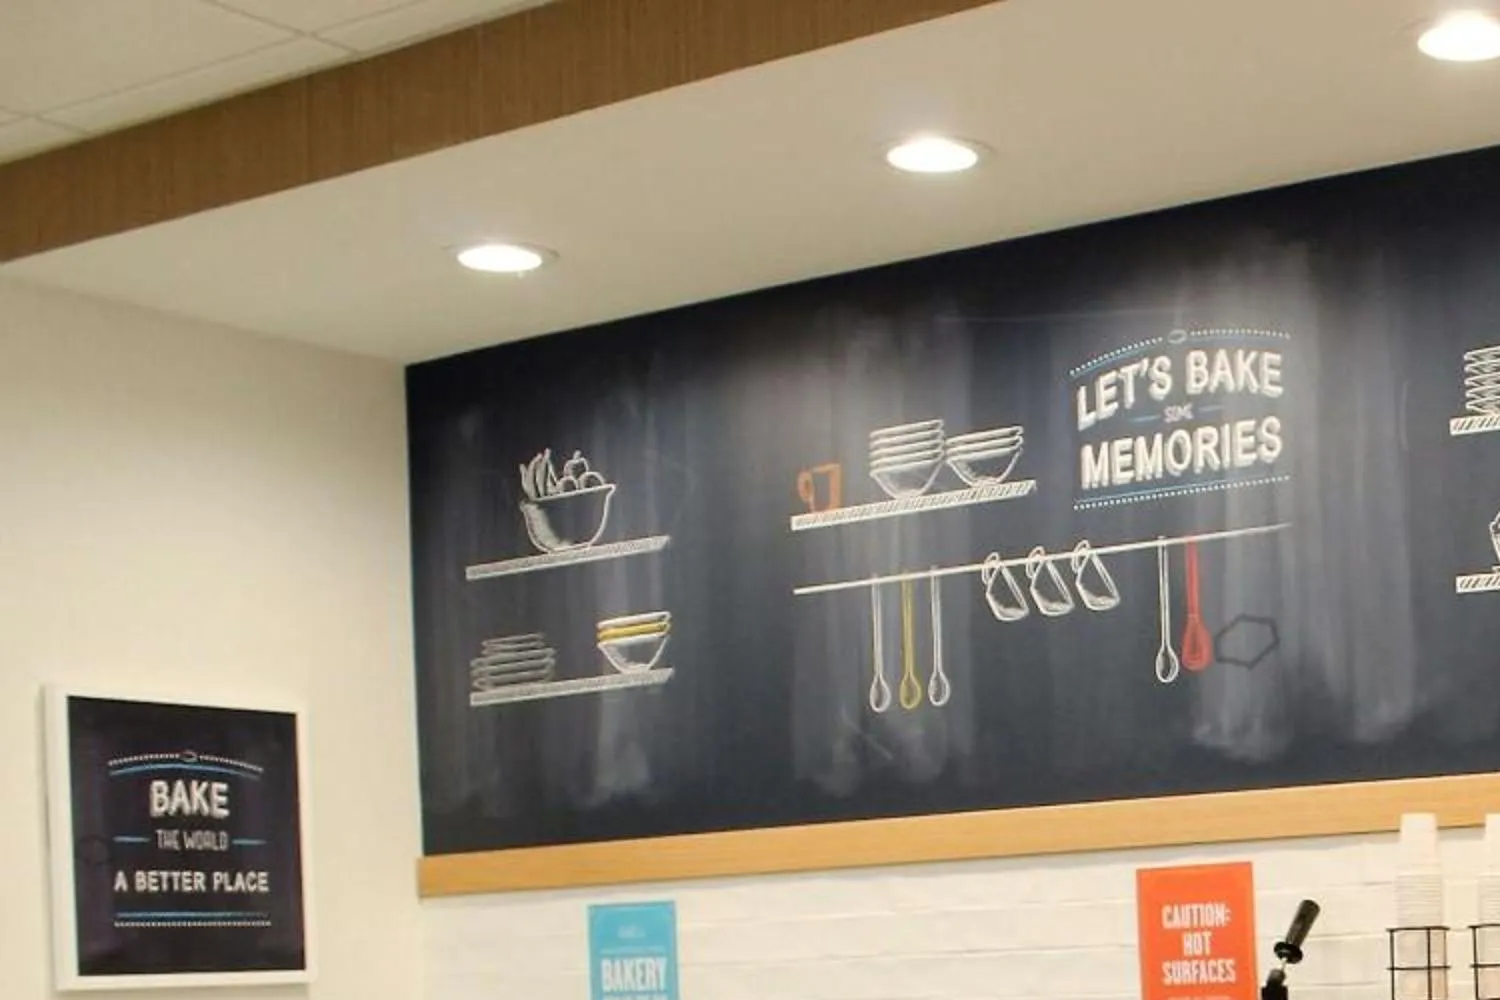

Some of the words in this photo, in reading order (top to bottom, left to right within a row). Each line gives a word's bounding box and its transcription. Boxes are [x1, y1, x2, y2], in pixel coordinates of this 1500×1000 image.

[1076, 355, 1172, 431] LET'S
[1185, 349, 1283, 398] BAKE
[1080, 415, 1283, 489] MEMORIES
[150, 780, 230, 818] BAKE
[156, 828, 180, 850] THE
[114, 871, 128, 892] A
[135, 871, 206, 892] BETTER
[212, 871, 269, 893] PLACE
[1182, 932, 1212, 955] HOT
[601, 956, 668, 993] BAKERY
[1161, 958, 1236, 986] SURFACES
